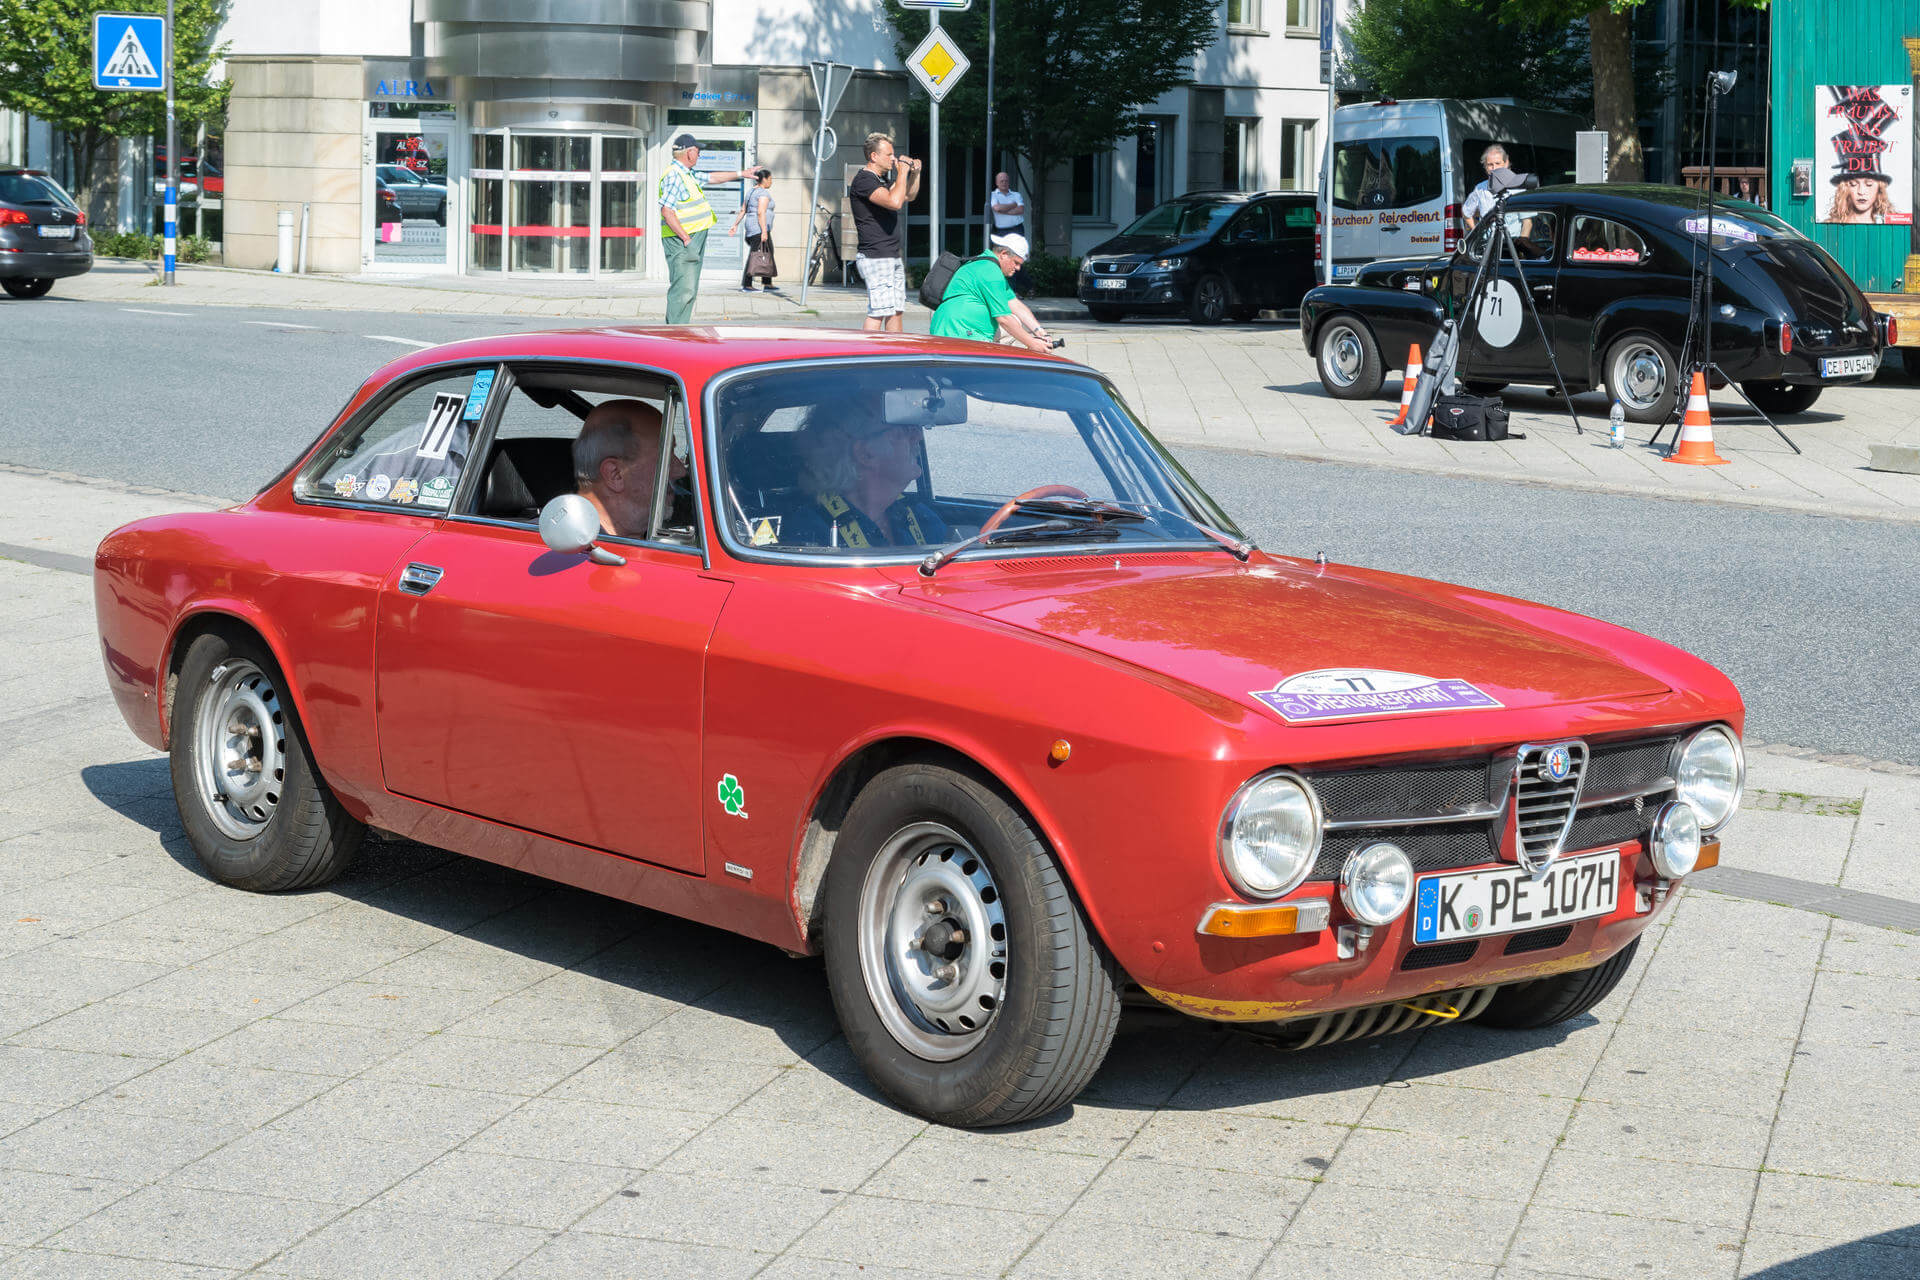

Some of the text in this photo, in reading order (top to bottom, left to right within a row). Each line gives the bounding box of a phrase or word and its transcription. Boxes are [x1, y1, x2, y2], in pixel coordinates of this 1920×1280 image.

[375, 79, 434, 97] ALRA
[682, 90, 722, 101] Redeker
[1846, 87, 1881, 102] WAS
[1847, 123, 1881, 137] WAS
[1832, 139, 1898, 154] TREIBST
[1378, 210, 1441, 225] Reisedienst
[1410, 235, 1441, 244] Detmold
[1490, 296, 1503, 317] 71
[1826, 358, 1873, 375] CE PV 54H
[419, 395, 464, 453] 77
[1334, 677, 1376, 692] 77
[1297, 684, 1456, 711] CHERUSKERFAHRT
[1422, 859, 1616, 933] D K PE 107H
